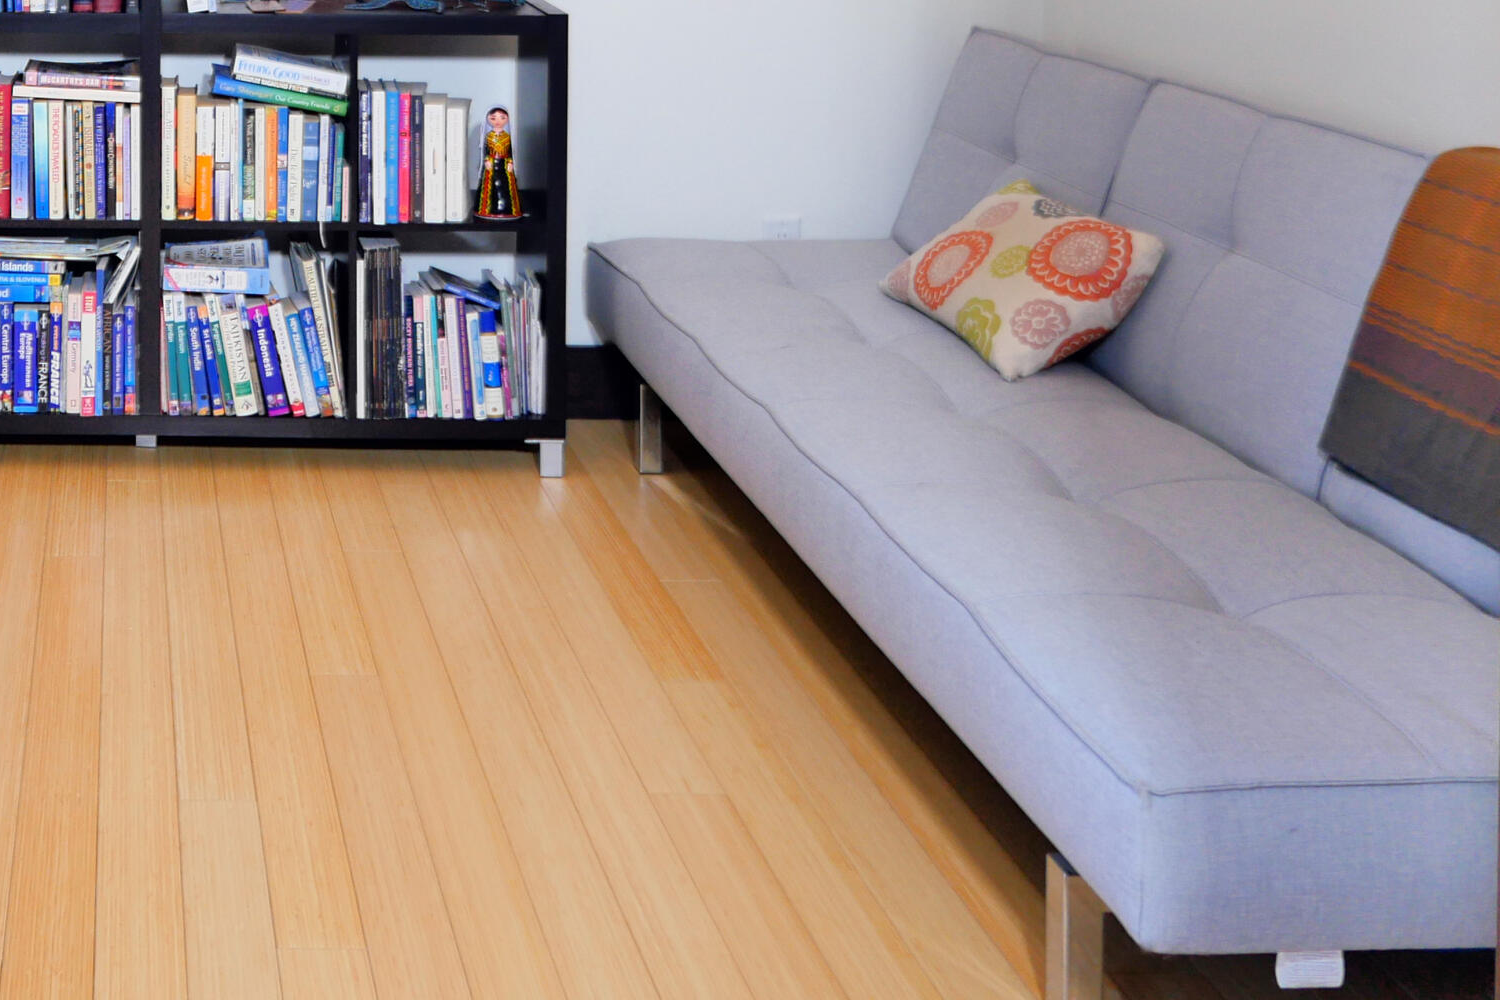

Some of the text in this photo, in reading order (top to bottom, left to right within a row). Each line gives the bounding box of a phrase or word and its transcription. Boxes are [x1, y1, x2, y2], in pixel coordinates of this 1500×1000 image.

[239, 61, 300, 80] FEELING GOOD
[20, 116, 28, 156] FREEDOM
[84, 127, 92, 156] ISHMAEL
[52, 151, 60, 183] TRAVELED
[2, 261, 34, 272] Islands
[305, 266, 321, 312] BEAUTIFUL
[314, 313, 330, 358] AUSTRALIA
[18, 333, 26, 359] Europe
[103, 309, 112, 354] AFRICAN
[166, 323, 174, 343] Jordan
[178, 325, 186, 354] Lebanon
[289, 318, 304, 362] NEW ZEALAND
[25, 333, 33, 388] Mediterranean
[69, 343, 77, 373] Germany
[190, 328, 202, 371] South India
[204, 340, 213, 360] Lanka
[257, 329, 273, 377] Indonesia
[0, 355, 9, 383] Europe
[39, 362, 47, 404] FRANCE
[50, 351, 60, 405] FRANCE
